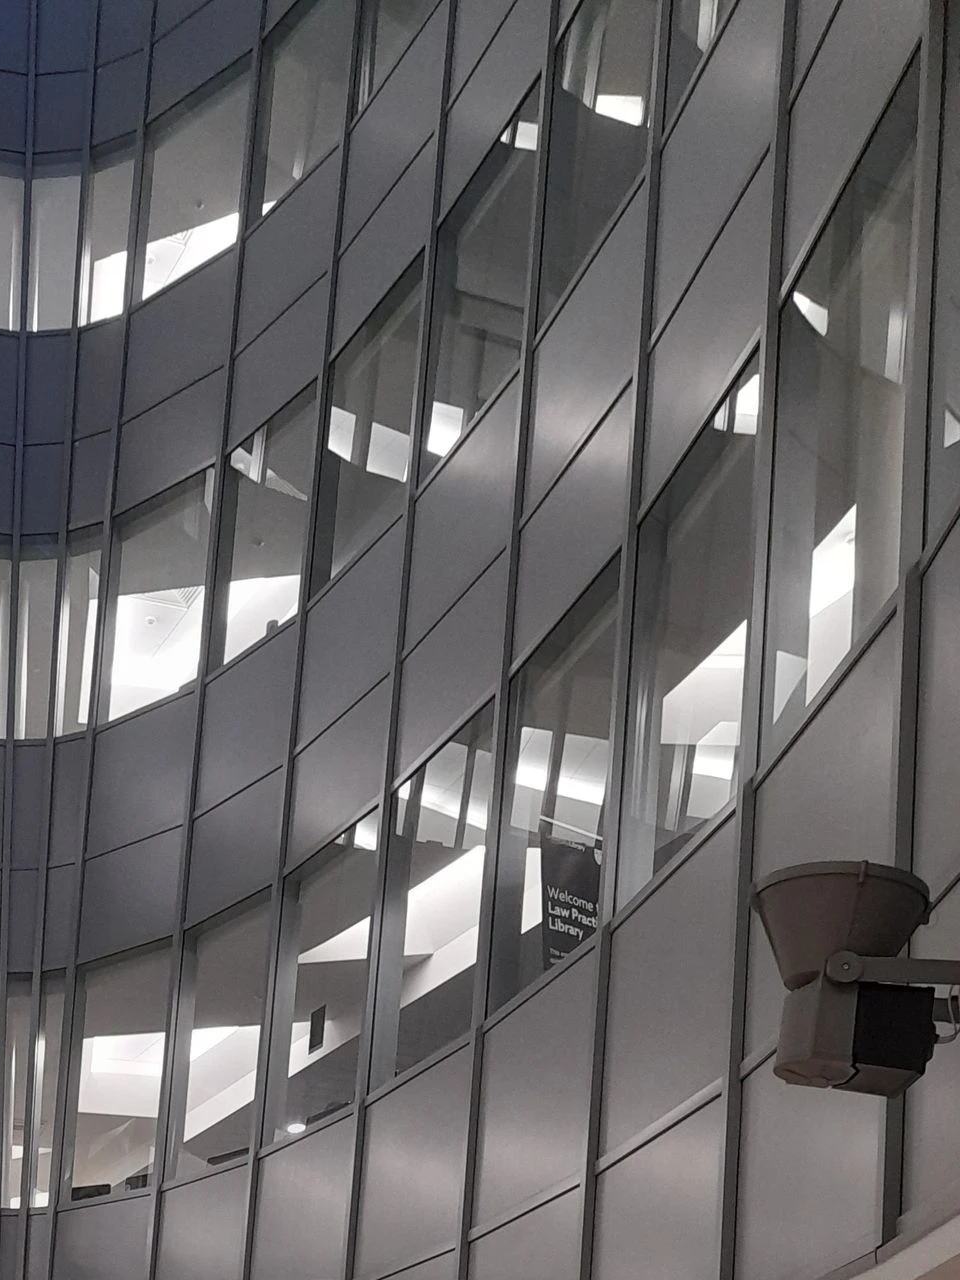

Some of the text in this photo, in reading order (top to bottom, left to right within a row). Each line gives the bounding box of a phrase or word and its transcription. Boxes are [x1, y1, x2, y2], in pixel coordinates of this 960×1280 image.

[547, 885, 594, 912] Welcome
[548, 901, 569, 919] Law
[549, 917, 583, 940] Library
